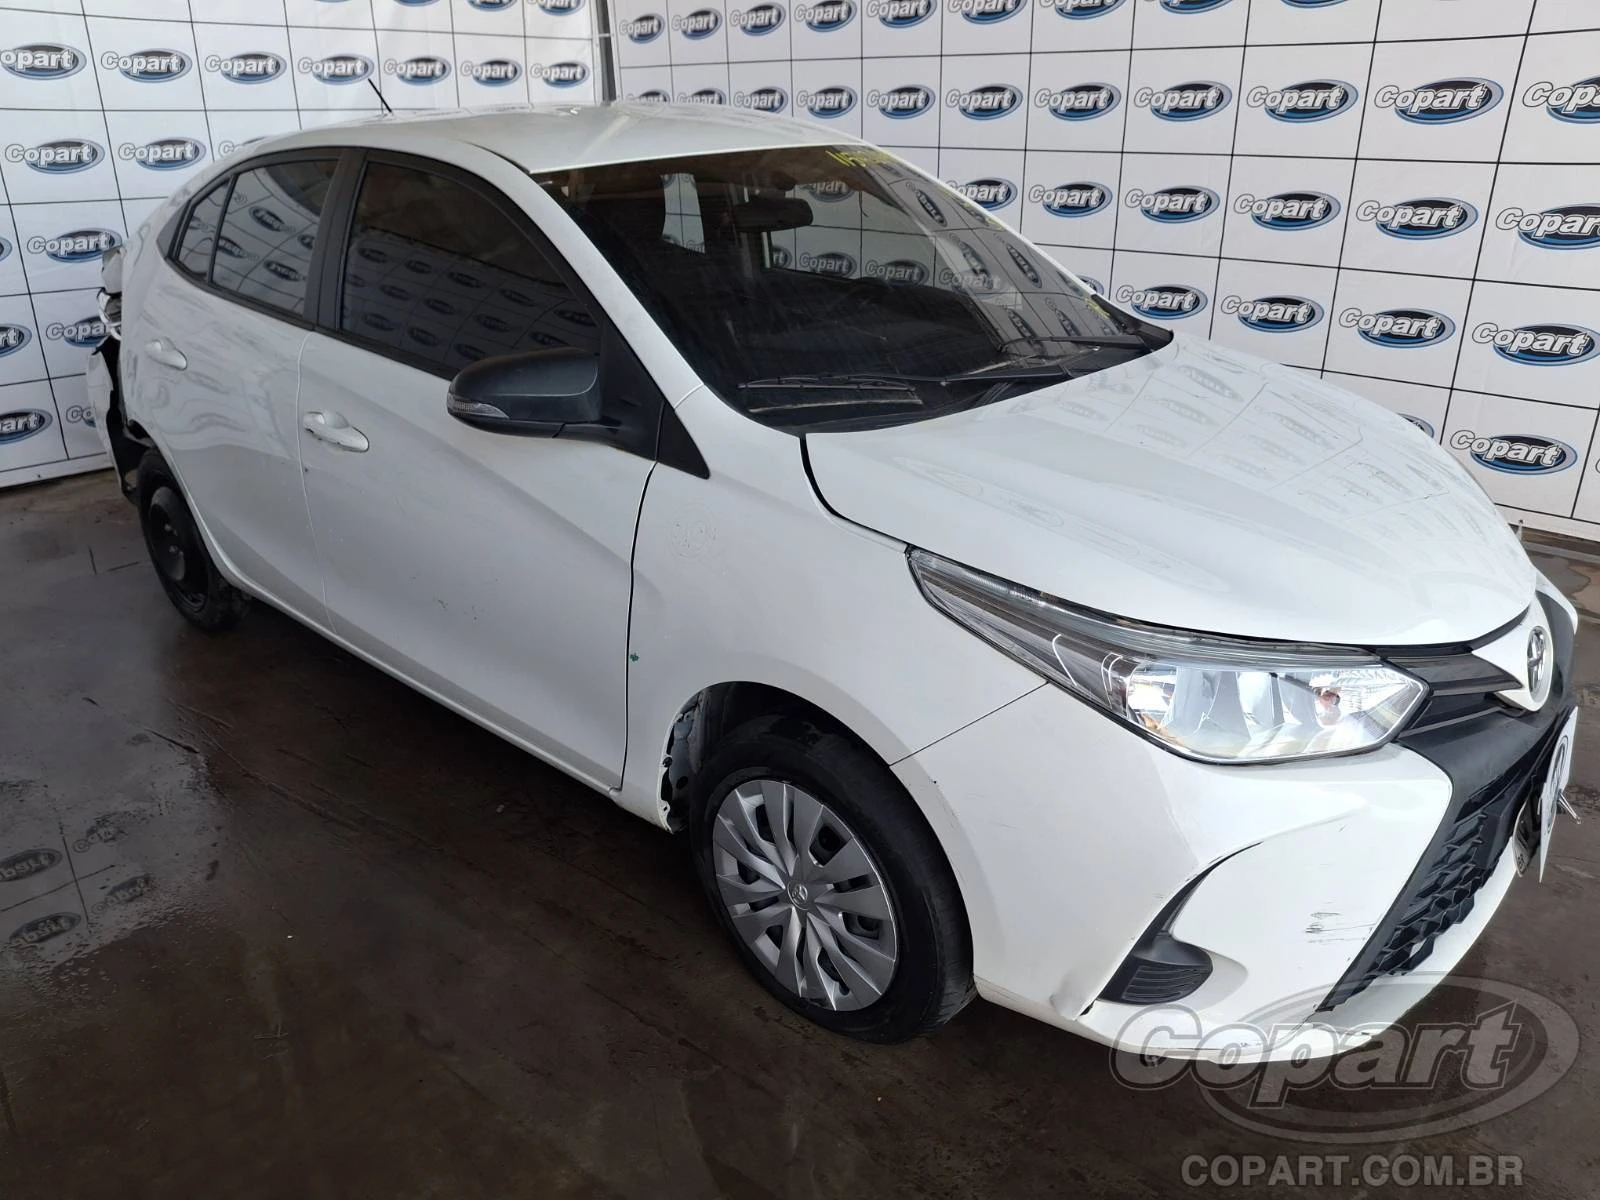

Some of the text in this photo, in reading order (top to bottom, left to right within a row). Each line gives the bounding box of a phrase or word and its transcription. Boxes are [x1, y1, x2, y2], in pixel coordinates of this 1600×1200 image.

[672, 13, 717, 36] Copart
[730, 9, 783, 33] Copart
[795, 1, 850, 28] Copart
[620, 17, 659, 38] Copart
[0, 49, 73, 70] opart
[101, 51, 182, 75] Copart
[205, 55, 276, 76] Copart
[298, 57, 365, 75] Copart
[383, 58, 443, 75] Copart
[460, 60, 518, 77] Copart
[530, 62, 584, 80] Copart
[796, 88, 851, 114] Copart
[867, 88, 928, 114] Copart
[946, 87, 1017, 115] Copart
[1035, 87, 1111, 114] Copart
[1134, 85, 1222, 114] Copart
[1247, 84, 1344, 115] Copart
[1375, 82, 1488, 115] Copart
[5, 143, 93, 167] Copart
[118, 141, 194, 163] Copart
[1029, 184, 1104, 208] Copart
[1125, 189, 1209, 214] Copart
[1233, 192, 1329, 220] Copart
[1356, 200, 1463, 230] Copart
[1496, 207, 1600, 238] Copar
[27, 232, 110, 256] Copart
[800, 252, 850, 274] Copart
[1116, 284, 1197, 312] Copart
[1221, 294, 1312, 324] Copart
[46, 322, 107, 343] Copa
[1339, 308, 1442, 339] Copart
[1472, 322, 1590, 356] Copart
[1450, 430, 1563, 467] Copart
